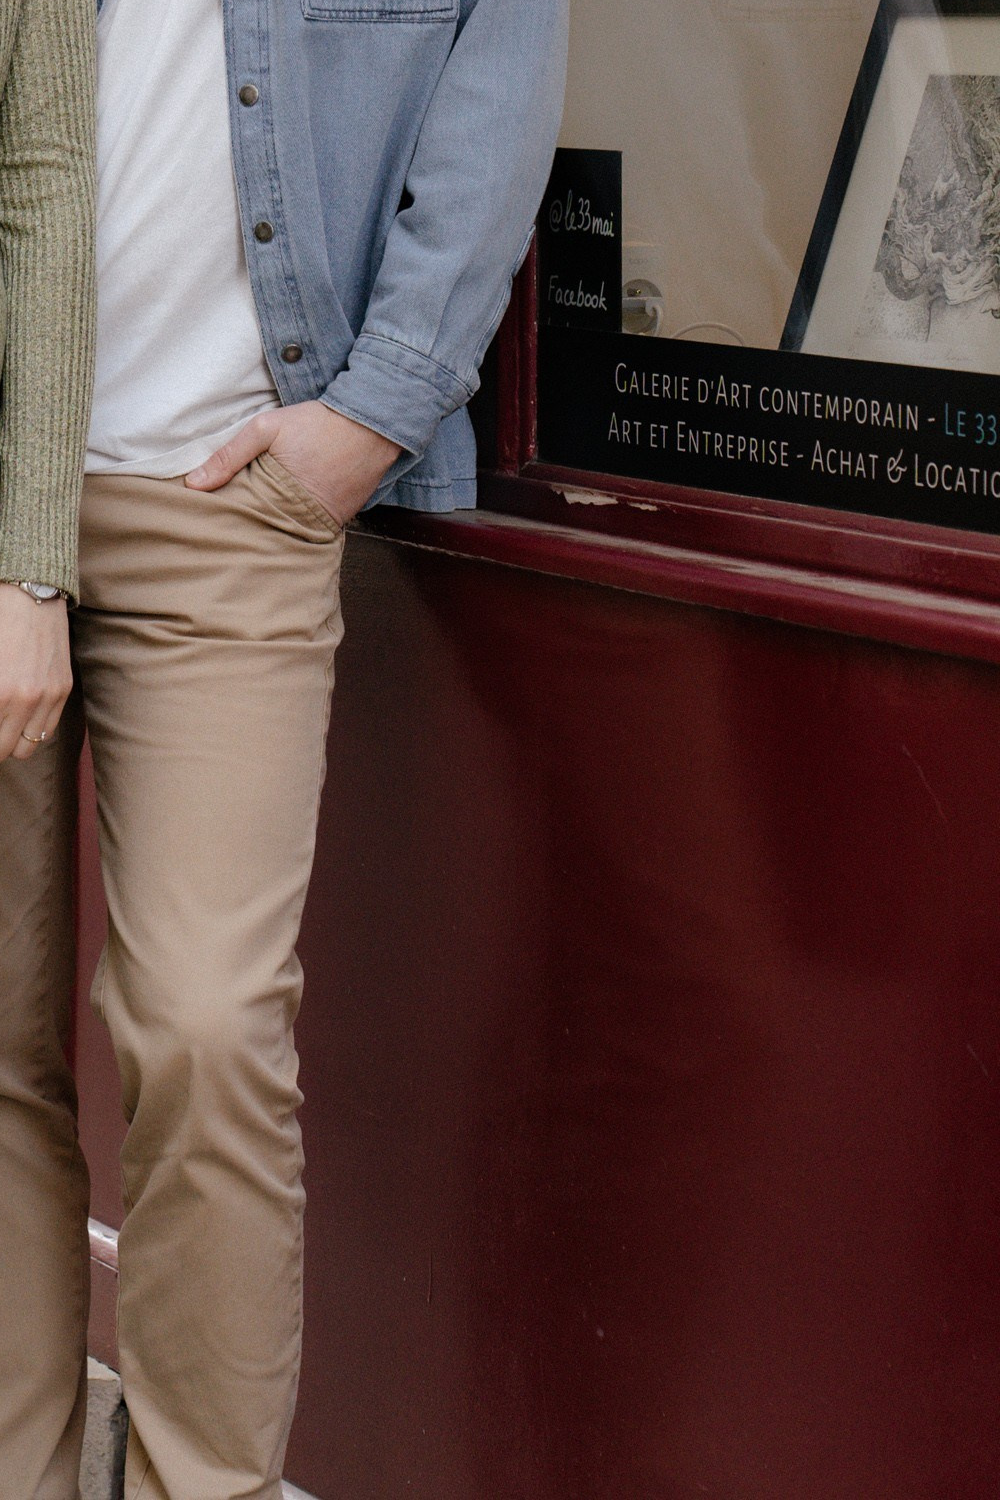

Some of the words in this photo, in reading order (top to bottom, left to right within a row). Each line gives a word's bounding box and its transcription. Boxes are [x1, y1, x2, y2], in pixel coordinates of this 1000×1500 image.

[550, 189, 615, 237] @le33mai
[548, 275, 607, 311] Facebook
[615, 362, 690, 401] GALERIE
[697, 374, 752, 409] D'ART
[759, 386, 919, 432] CONTEMPORAIN
[944, 402, 967, 438] LE
[975, 412, 998, 446] 33
[607, 411, 643, 445] ART
[649, 423, 669, 449] ET
[676, 420, 790, 468] ENTREPRISE
[811, 439, 879, 480] ACHAT
[886, 448, 908, 484] &
